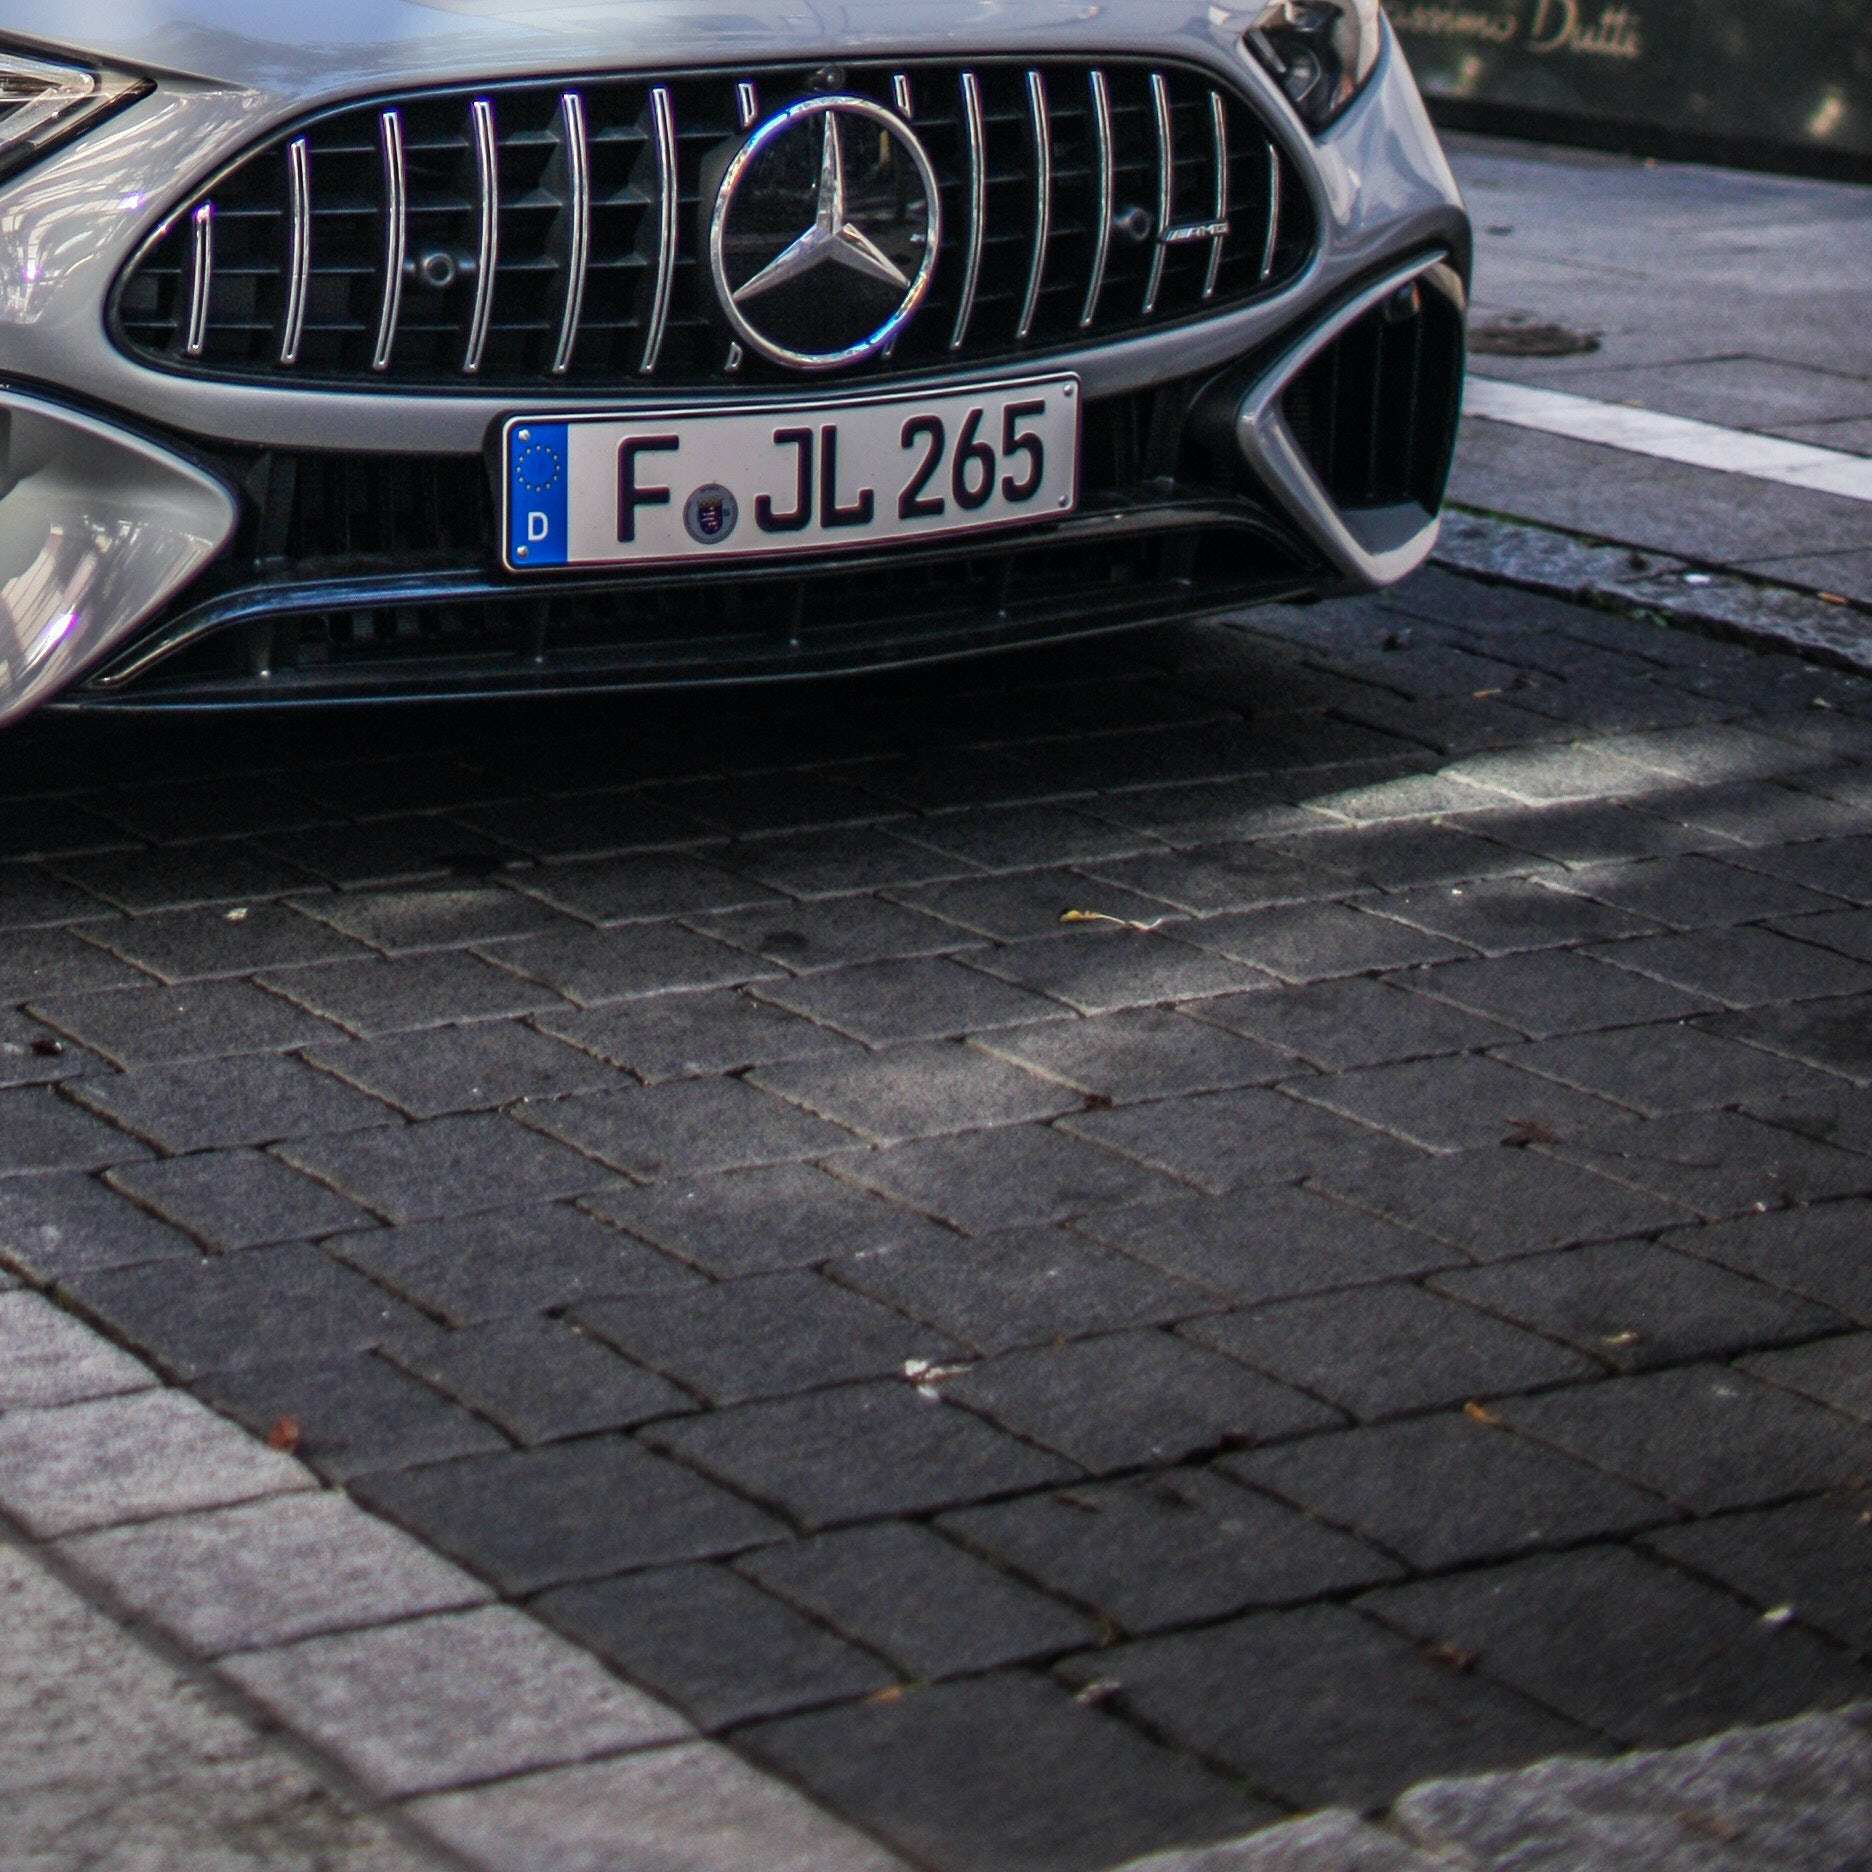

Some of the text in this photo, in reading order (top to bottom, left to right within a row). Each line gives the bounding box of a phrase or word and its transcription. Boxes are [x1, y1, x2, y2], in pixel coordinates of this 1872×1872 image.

[616, 399, 1046, 543] F JL 265
[528, 512, 549, 542] D
